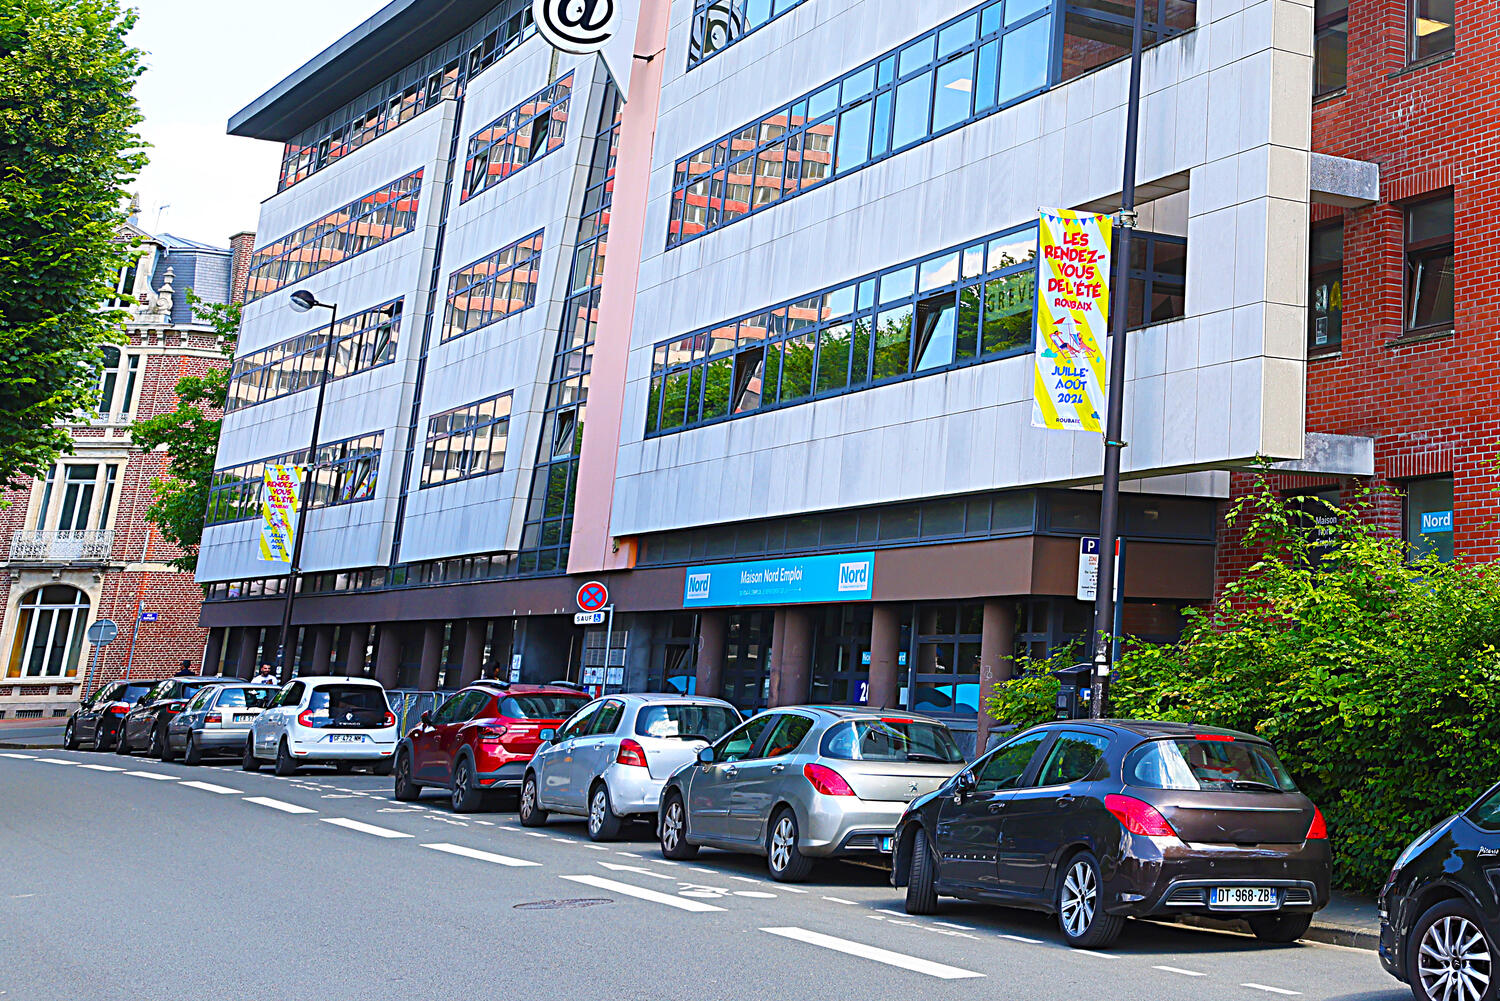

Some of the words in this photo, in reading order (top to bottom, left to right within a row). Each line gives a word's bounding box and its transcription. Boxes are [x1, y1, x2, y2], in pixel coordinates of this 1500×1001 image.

[1063, 231, 1089, 247] LES
[1045, 244, 1105, 264] RENDEZ-
[1057, 262, 1095, 280] VOUS
[1054, 297, 1093, 311] ROUBAIX
[1055, 378, 1088, 391] AOÛT
[1423, 512, 1451, 528] Nord
[1087, 540, 1096, 553] P
[741, 569, 763, 584] Maison
[764, 567, 780, 583] Nord
[780, 565, 803, 584] Emploi
[840, 563, 867, 584] Nord
[688, 575, 710, 593] Nord
[1218, 888, 1270, 903] DT-968-ZB
